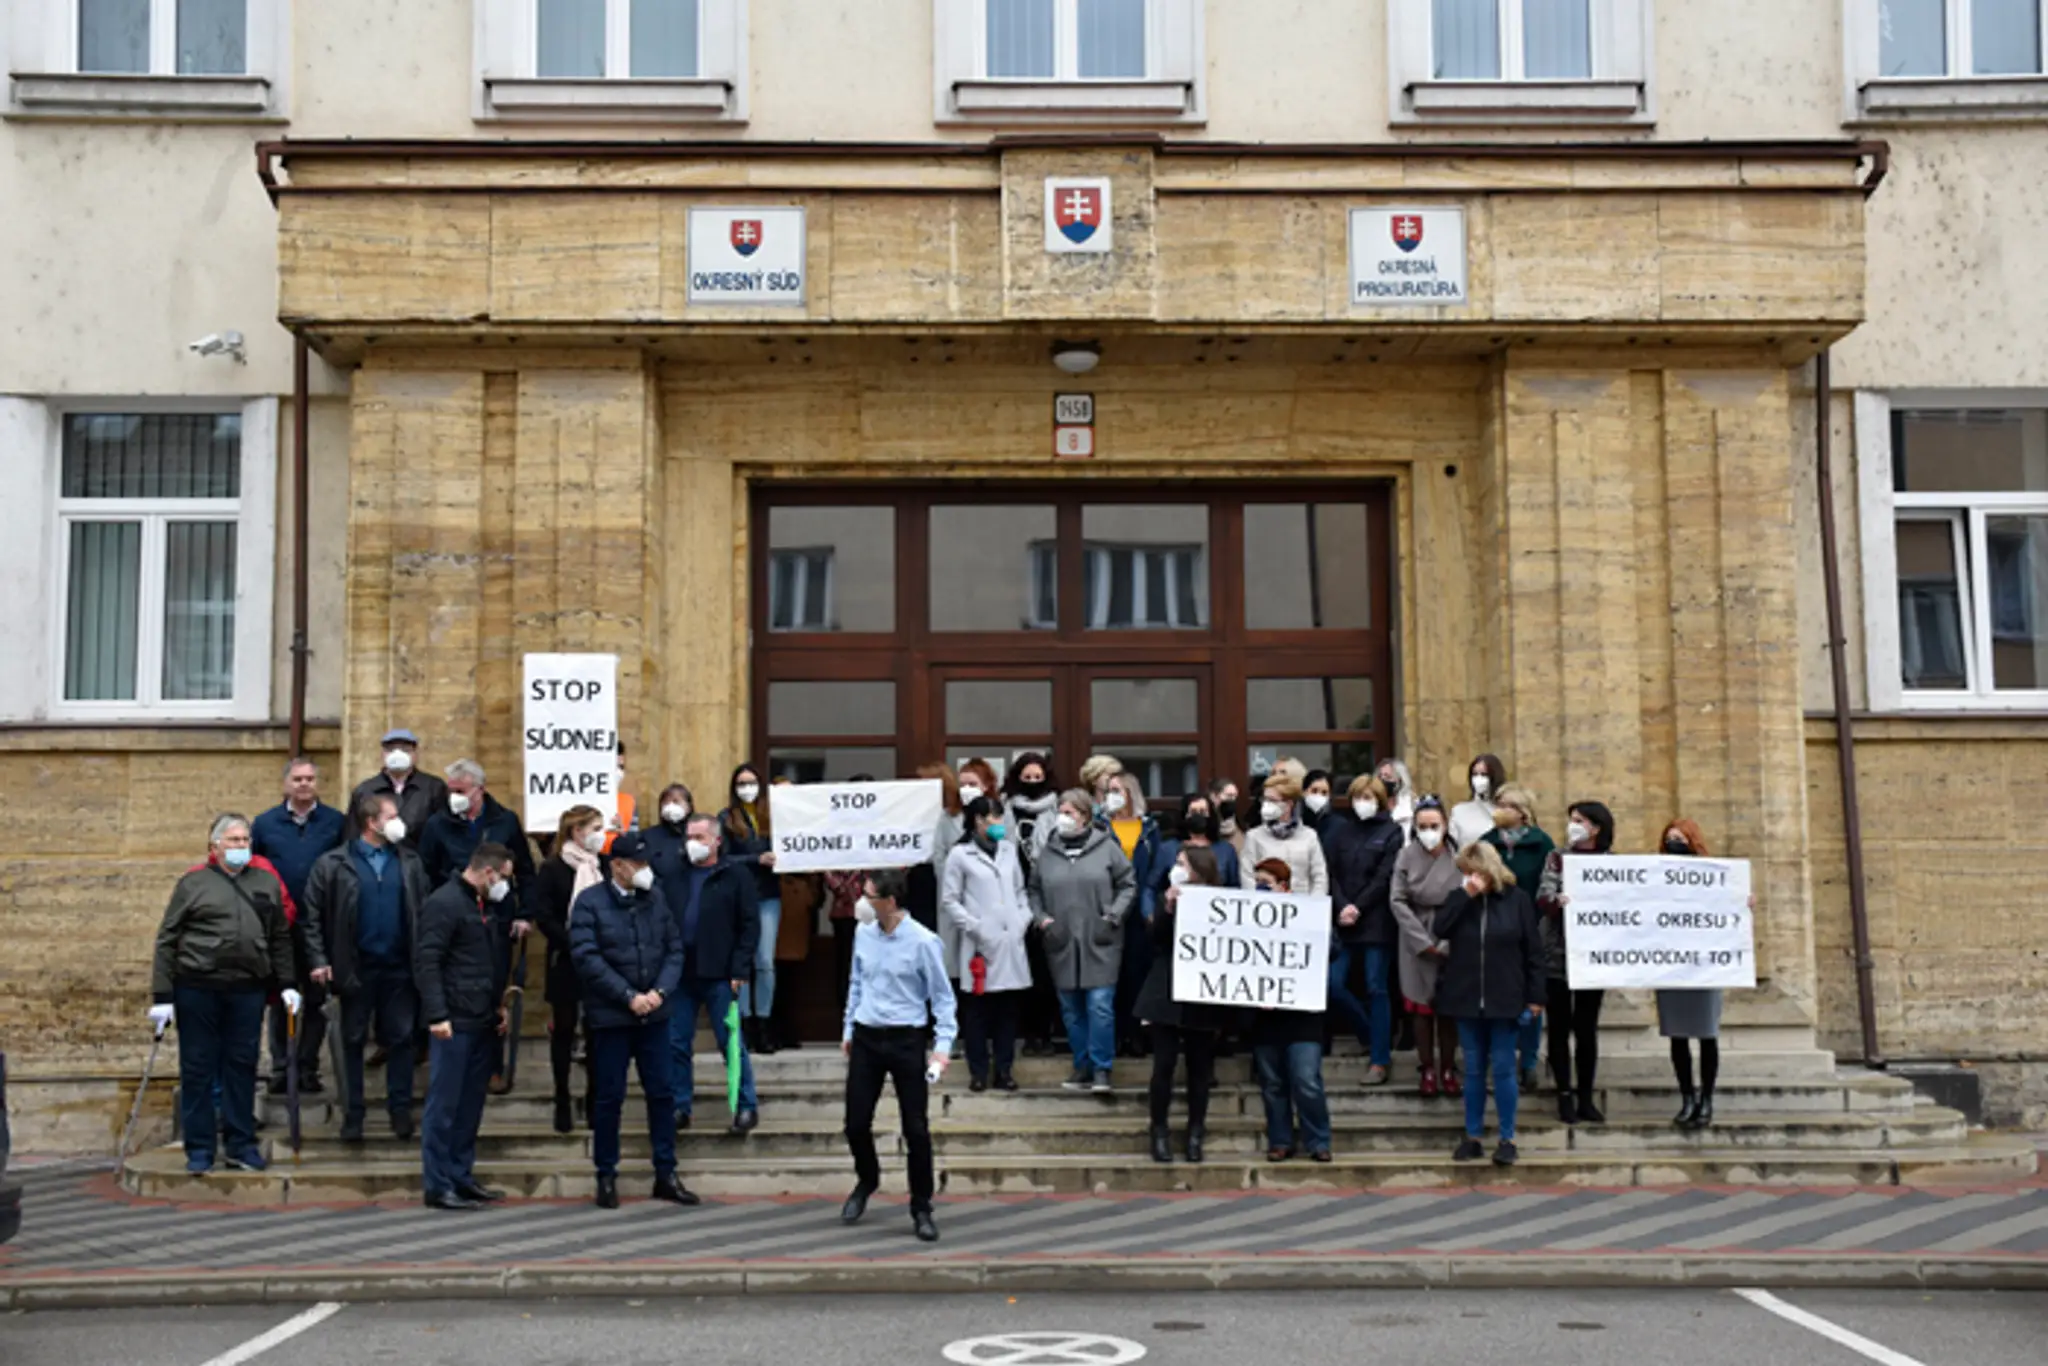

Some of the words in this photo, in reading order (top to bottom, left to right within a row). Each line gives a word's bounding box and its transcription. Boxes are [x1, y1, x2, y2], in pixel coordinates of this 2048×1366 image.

[1378, 255, 1437, 275] OKRESNÁ
[693, 268, 764, 291] OKRESNÝ
[767, 267, 800, 291] SÚD
[1357, 277, 1460, 297] PROKURATÚRA
[531, 678, 602, 701] STOP
[526, 722, 617, 751] SÚDNEJ
[529, 772, 610, 794] MAPE
[830, 792, 877, 810] STOP
[781, 832, 853, 853] SÚDNEJ
[869, 833, 922, 849] MAPE
[1582, 868, 1647, 884] KONIEC
[1209, 896, 1298, 929] STOP
[1577, 910, 1641, 927] KONIEC
[1657, 912, 1726, 928] OKRESU
[1179, 928, 1312, 970] SÚDNEJ
[1709, 950, 1732, 966] TO
[1199, 971, 1296, 1005] MAPE
